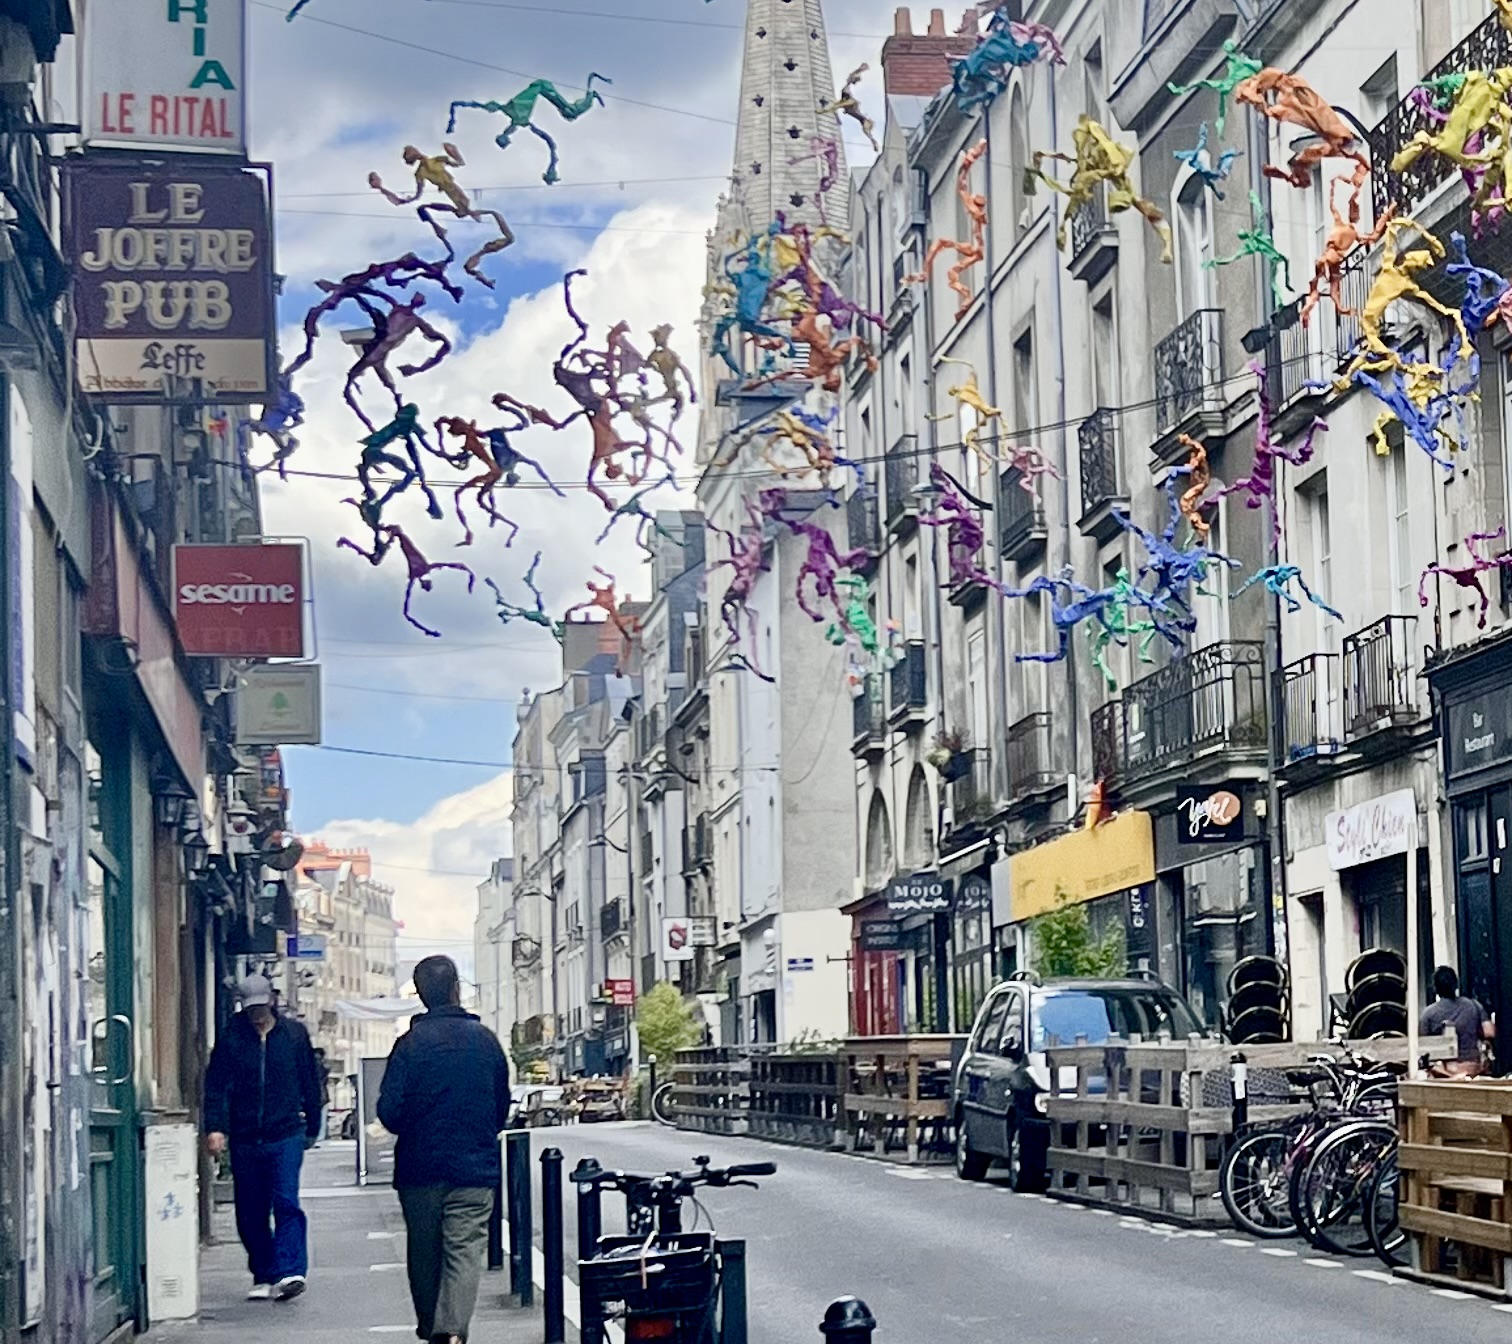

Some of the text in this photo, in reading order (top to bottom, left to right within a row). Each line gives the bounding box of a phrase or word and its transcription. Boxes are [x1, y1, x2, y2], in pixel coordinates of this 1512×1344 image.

[102, 92, 234, 138] LE RITAL
[128, 183, 205, 224] LE
[80, 227, 257, 274] JOFFRE
[101, 279, 232, 330] PUB
[140, 341, 206, 375] Leffe
[180, 584, 295, 604] sesame
[894, 883, 943, 898] MOJO
